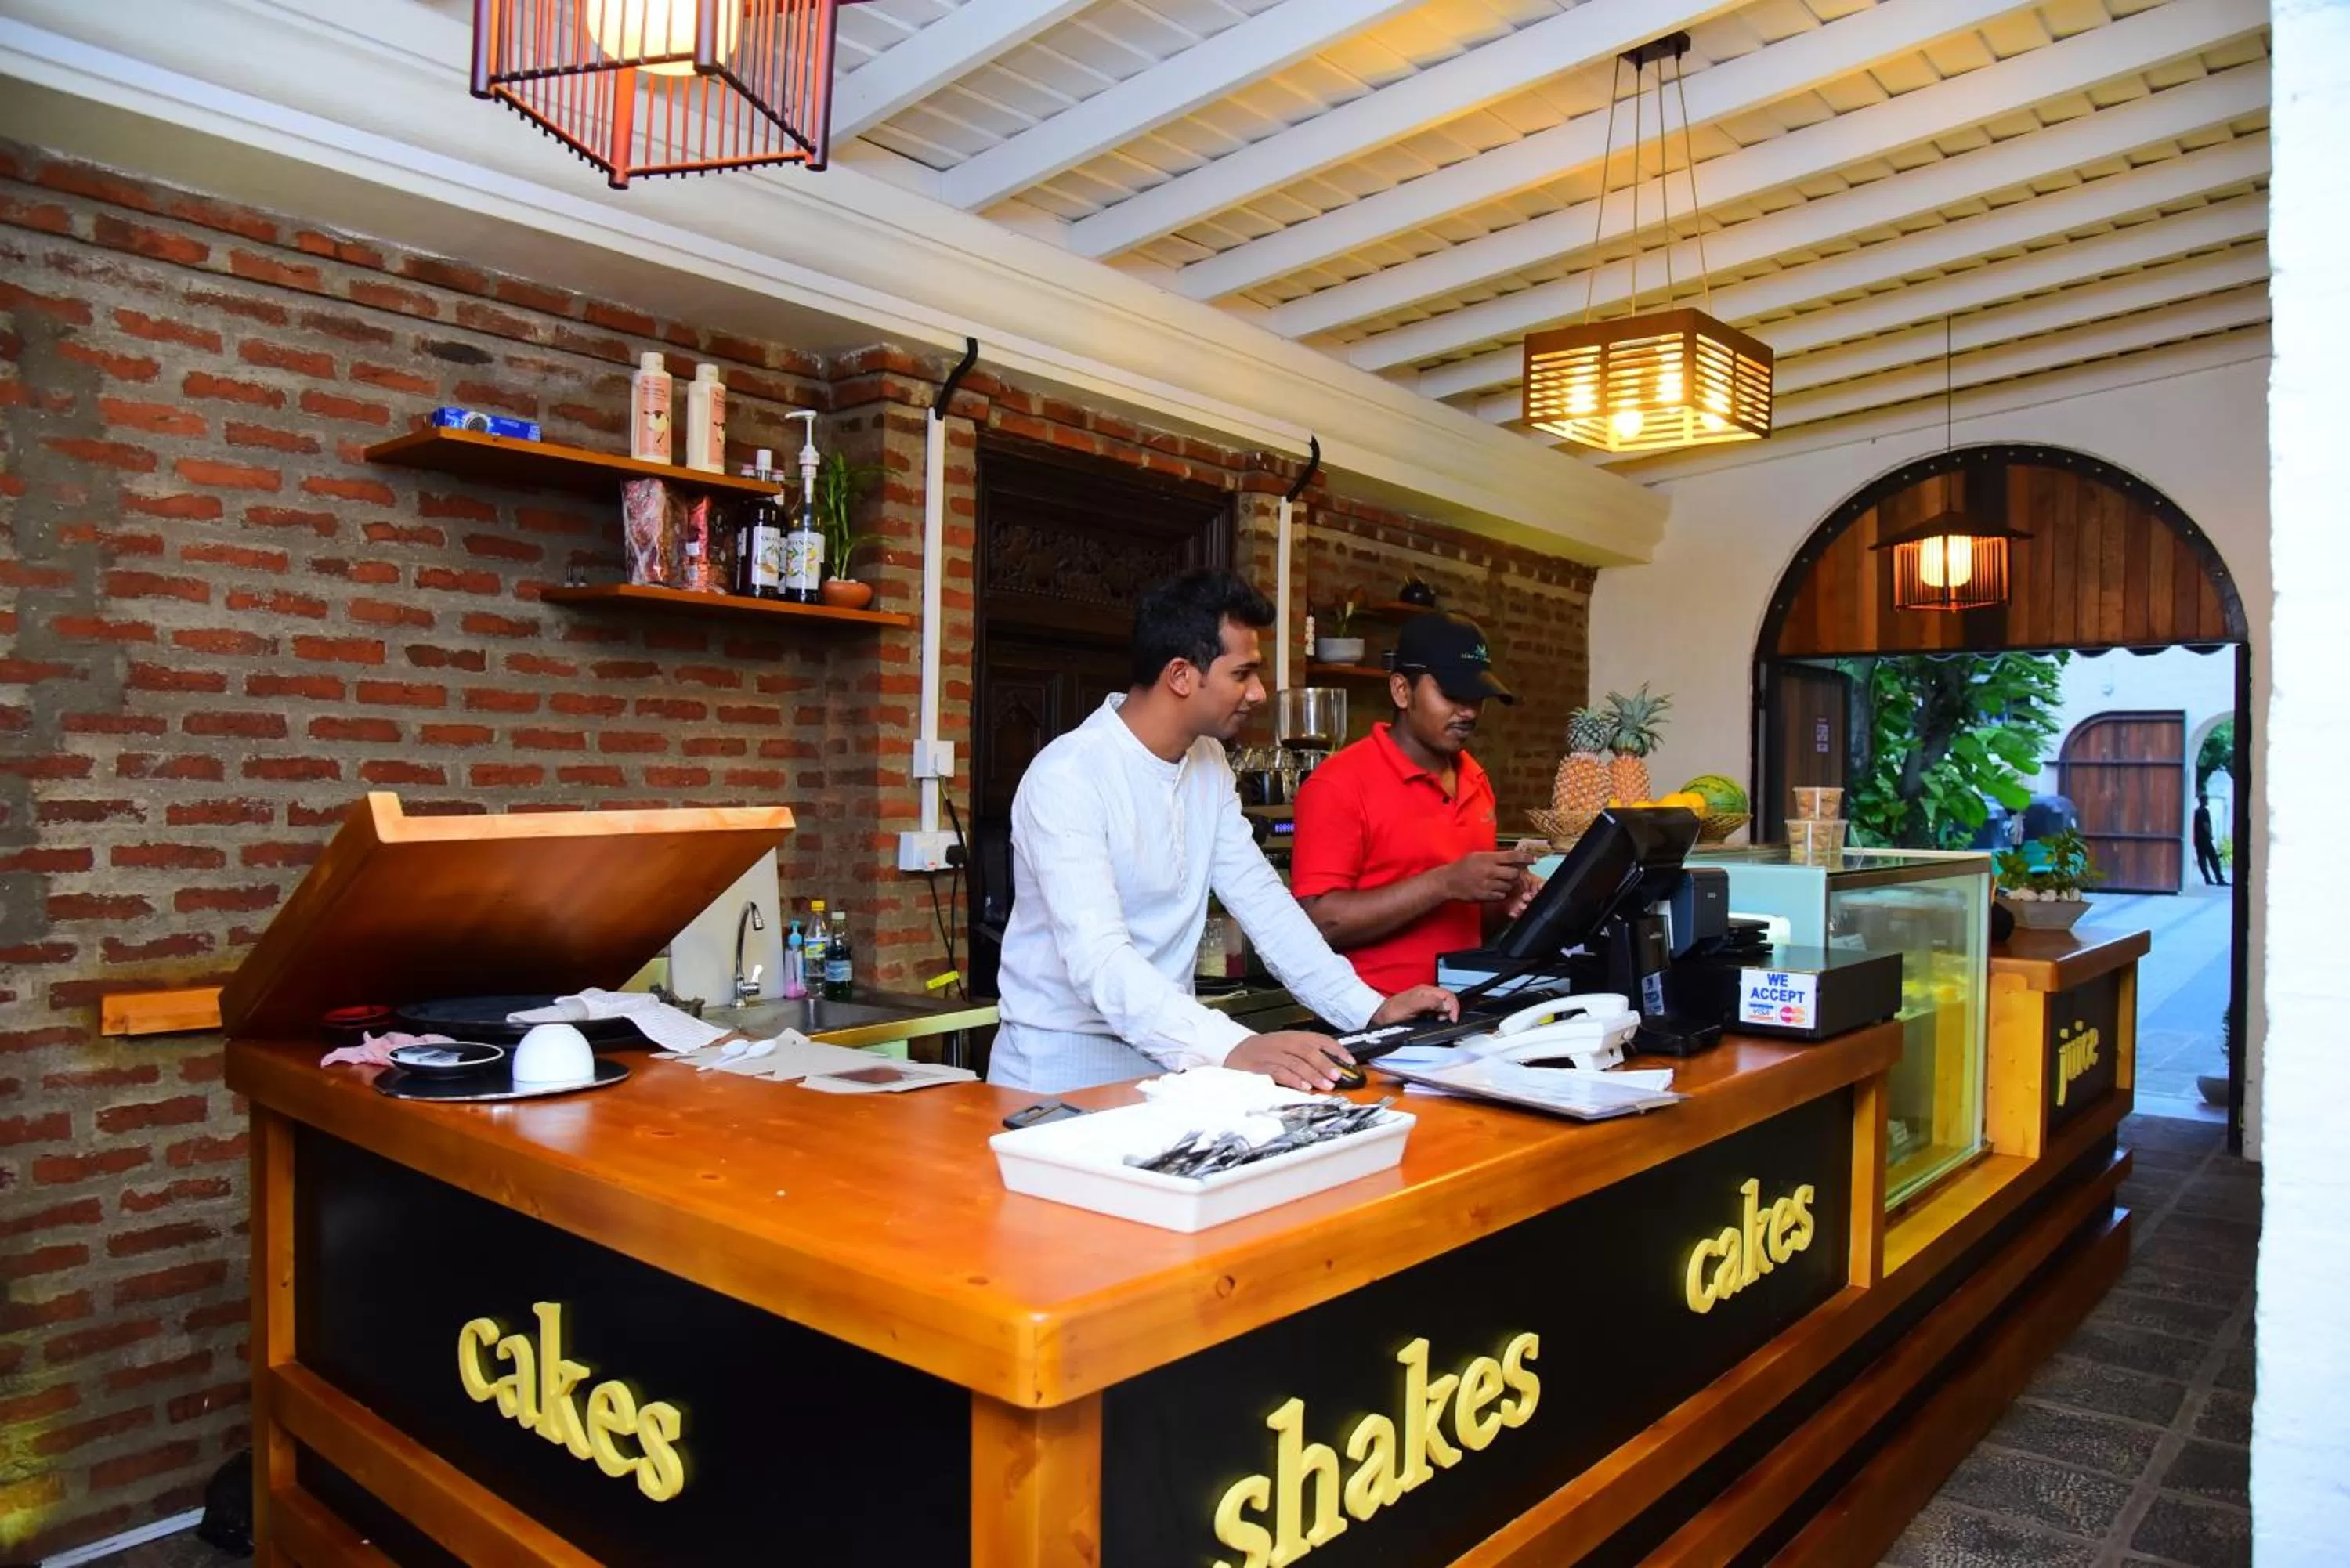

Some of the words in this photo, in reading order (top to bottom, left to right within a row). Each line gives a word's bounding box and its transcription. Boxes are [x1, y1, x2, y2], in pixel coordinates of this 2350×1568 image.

[1750, 987, 1805, 1003] ACCEPT
[1767, 974, 1788, 987] WE
[1686, 1177, 1814, 1313] cakes
[458, 1301, 684, 1502] cakes
[1212, 1331, 1541, 1568] shakes
